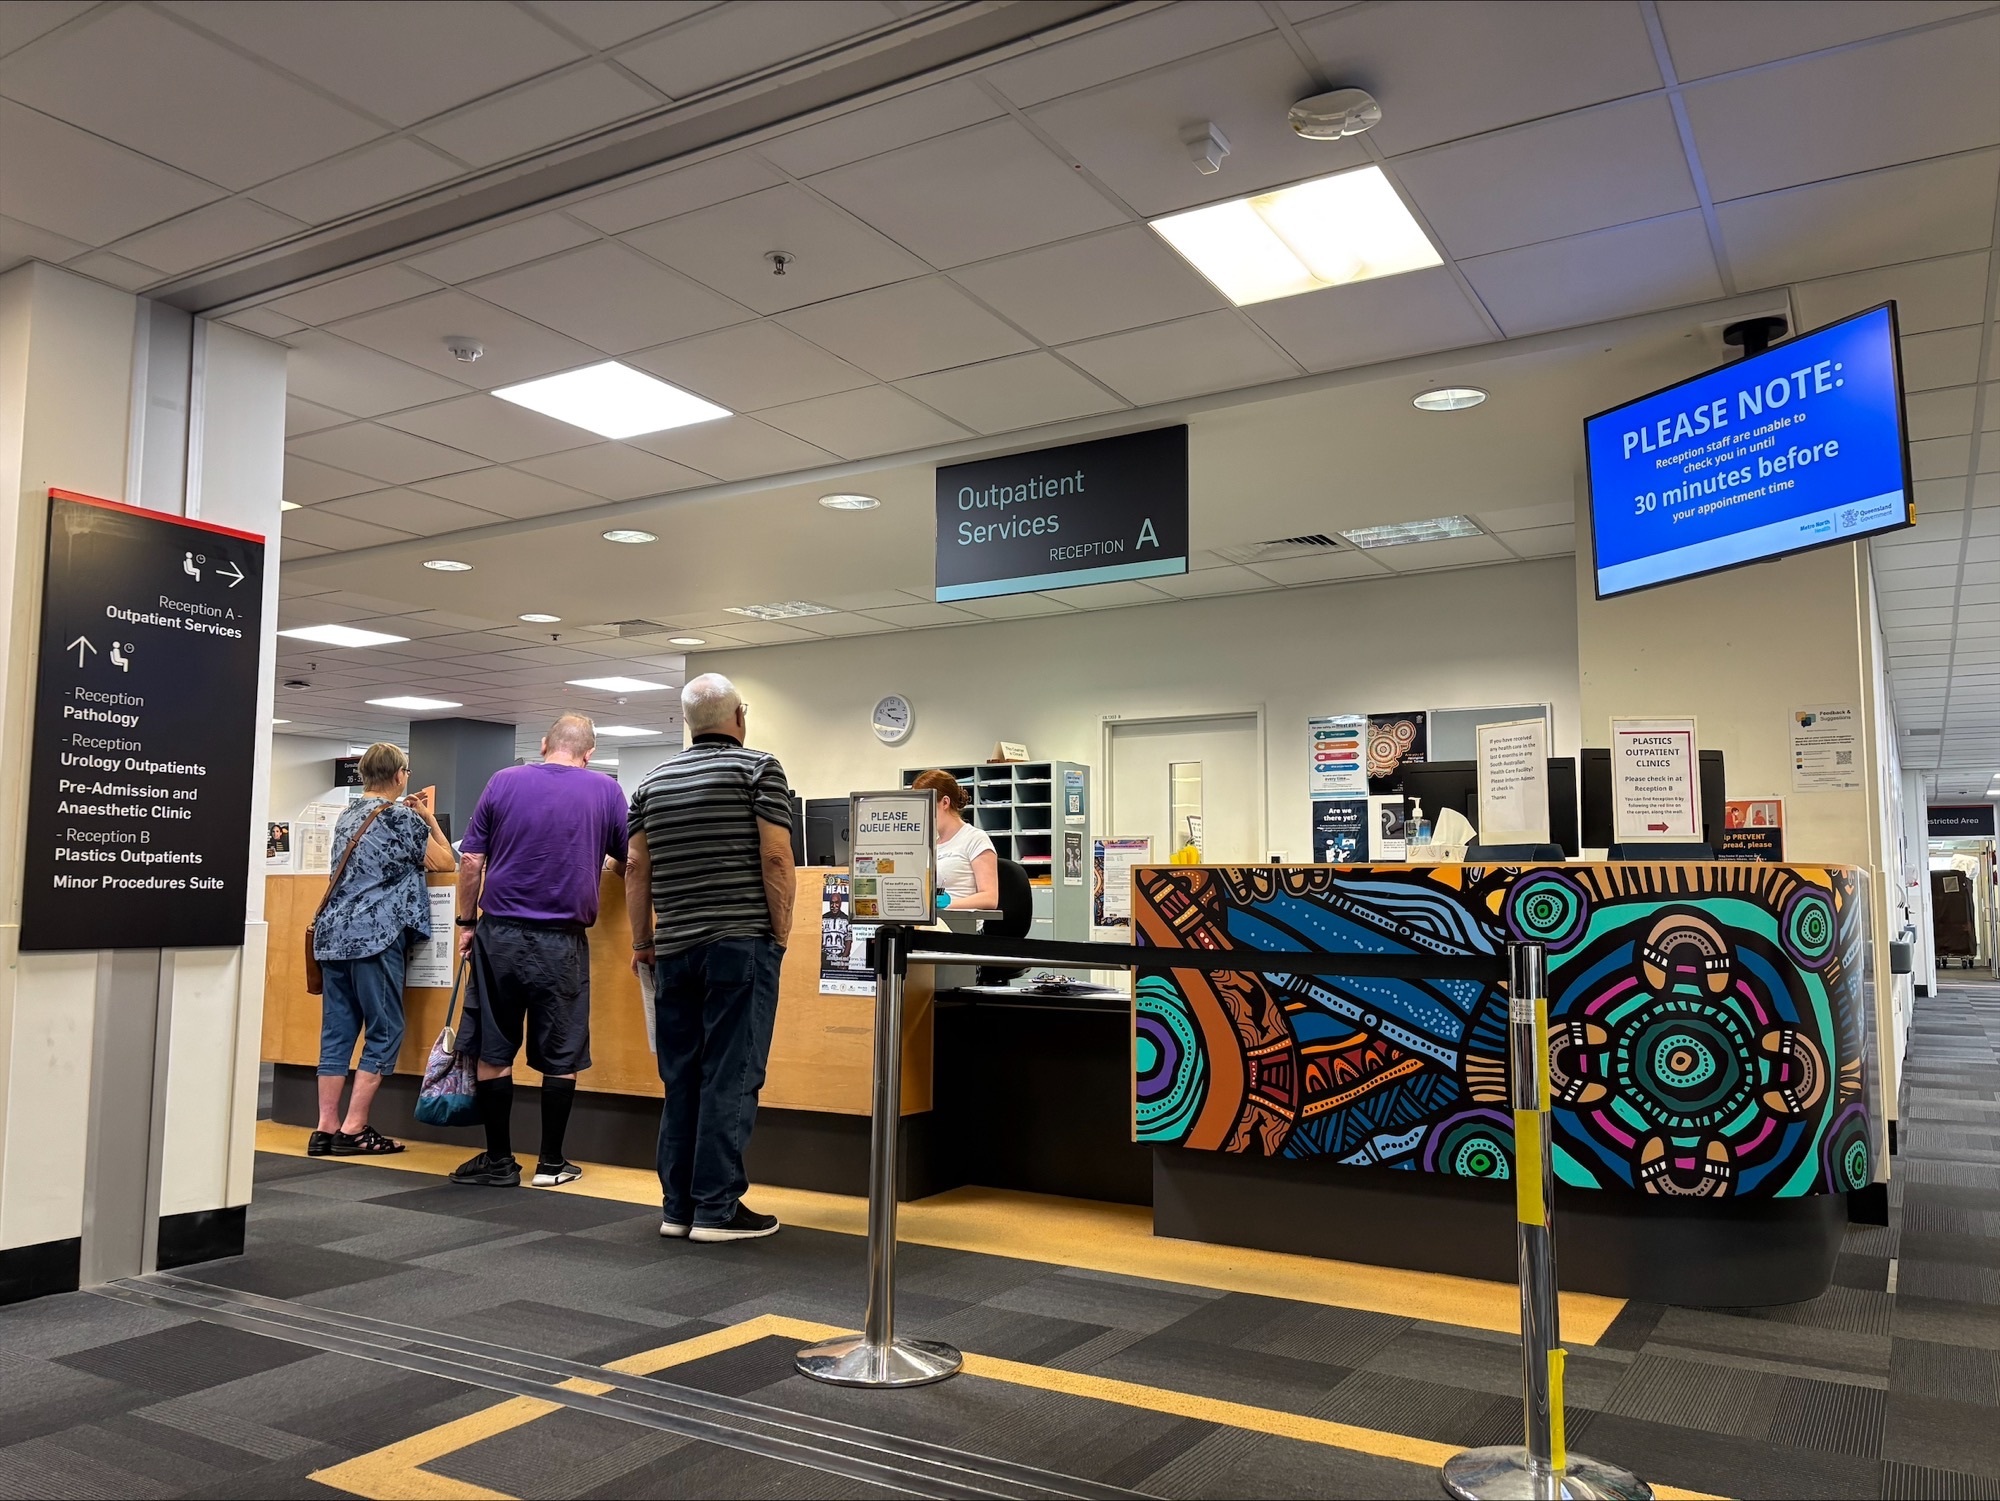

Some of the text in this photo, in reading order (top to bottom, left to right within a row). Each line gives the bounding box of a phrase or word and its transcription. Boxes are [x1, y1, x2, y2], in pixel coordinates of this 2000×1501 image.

[1622, 359, 1845, 460] PLEASE NOTE:
[1656, 412, 1807, 469] Reception staff are unable to
[1683, 436, 1775, 474] check you in until
[1634, 440, 1839, 515] 30 minutes before
[958, 470, 1085, 512] Outpatient
[1672, 478, 1795, 524] your appointment time
[1860, 503, 1892, 516] Queensland
[1860, 510, 1893, 522] Government
[958, 514, 1060, 546] Services
[1050, 518, 1160, 561] RECEPTION A
[159, 595, 222, 618] Reception
[225, 608, 235, 621] A
[106, 605, 243, 639] Outpatient Services
[74, 686, 145, 707] Reception
[64, 706, 140, 728] Pathology
[72, 733, 142, 752] Reception
[1625, 748, 1680, 756] OUTPATIENT
[60, 752, 207, 776] Urology Outpatients
[59, 779, 198, 800] Pre-Admission and
[58, 801, 192, 820] Anaesthetic Clinic
[871, 812, 908, 821] PLEASE
[1343, 814, 1357, 822] yet?
[66, 828, 137, 845] Reception
[140, 831, 151, 844] B
[860, 822, 921, 833] QUEUE HERE
[1723, 842, 1746, 850] pread,
[55, 848, 203, 866] Plastics Outpatients
[53, 875, 225, 890] Minor Procedures Suite
[826, 885, 849, 894] HEALT
